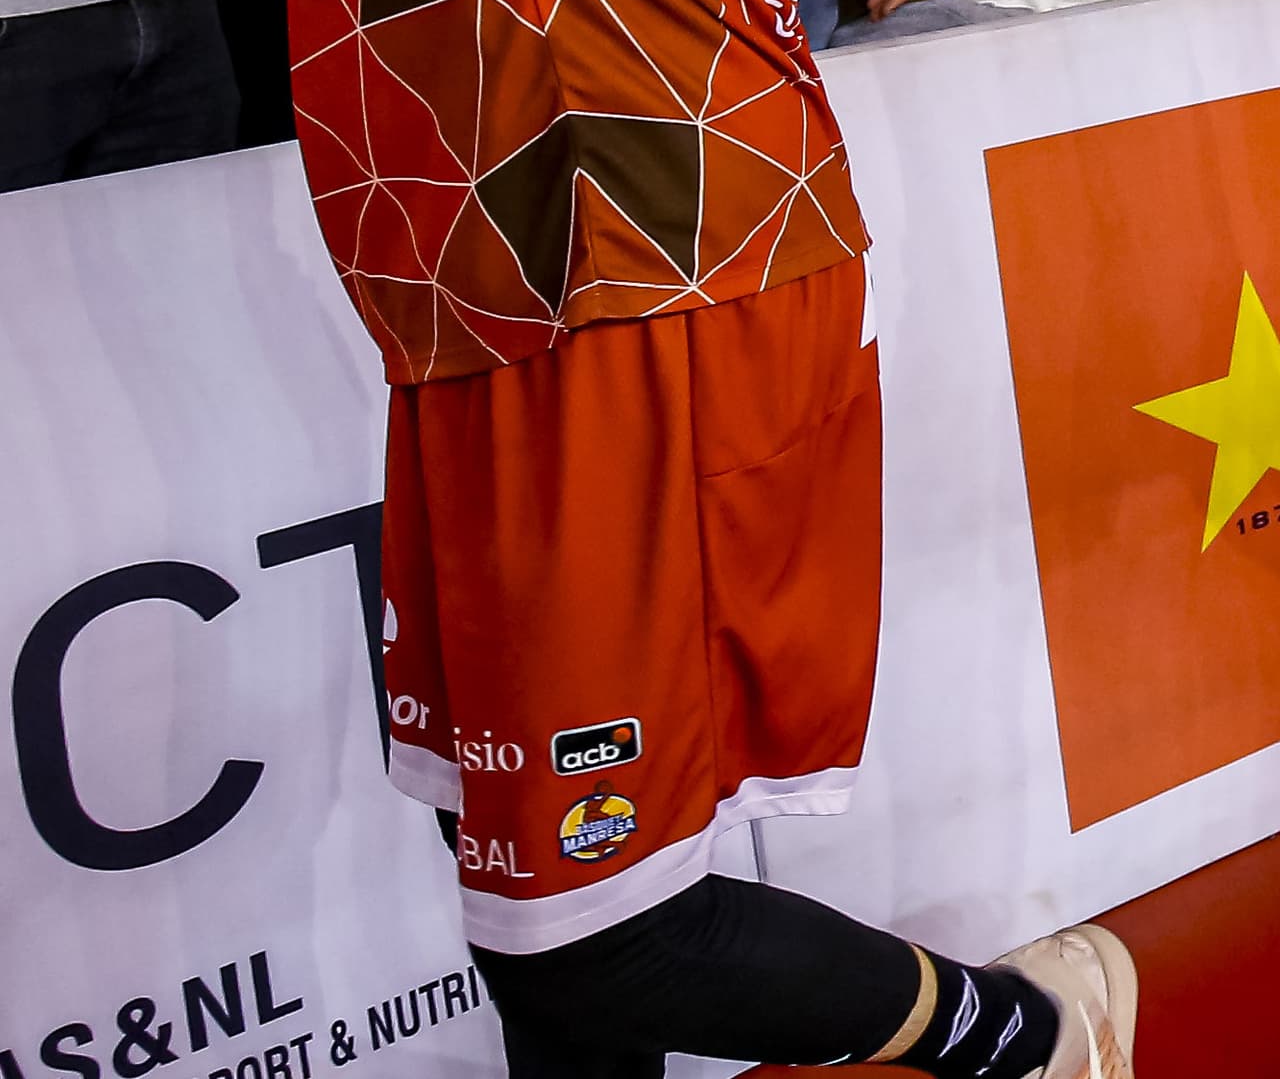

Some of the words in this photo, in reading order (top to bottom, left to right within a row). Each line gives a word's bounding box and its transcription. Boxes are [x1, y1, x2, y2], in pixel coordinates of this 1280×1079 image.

[562, 742, 621, 770] acb
[562, 819, 637, 856] MANRESA
[329, 1019, 358, 1067] &
